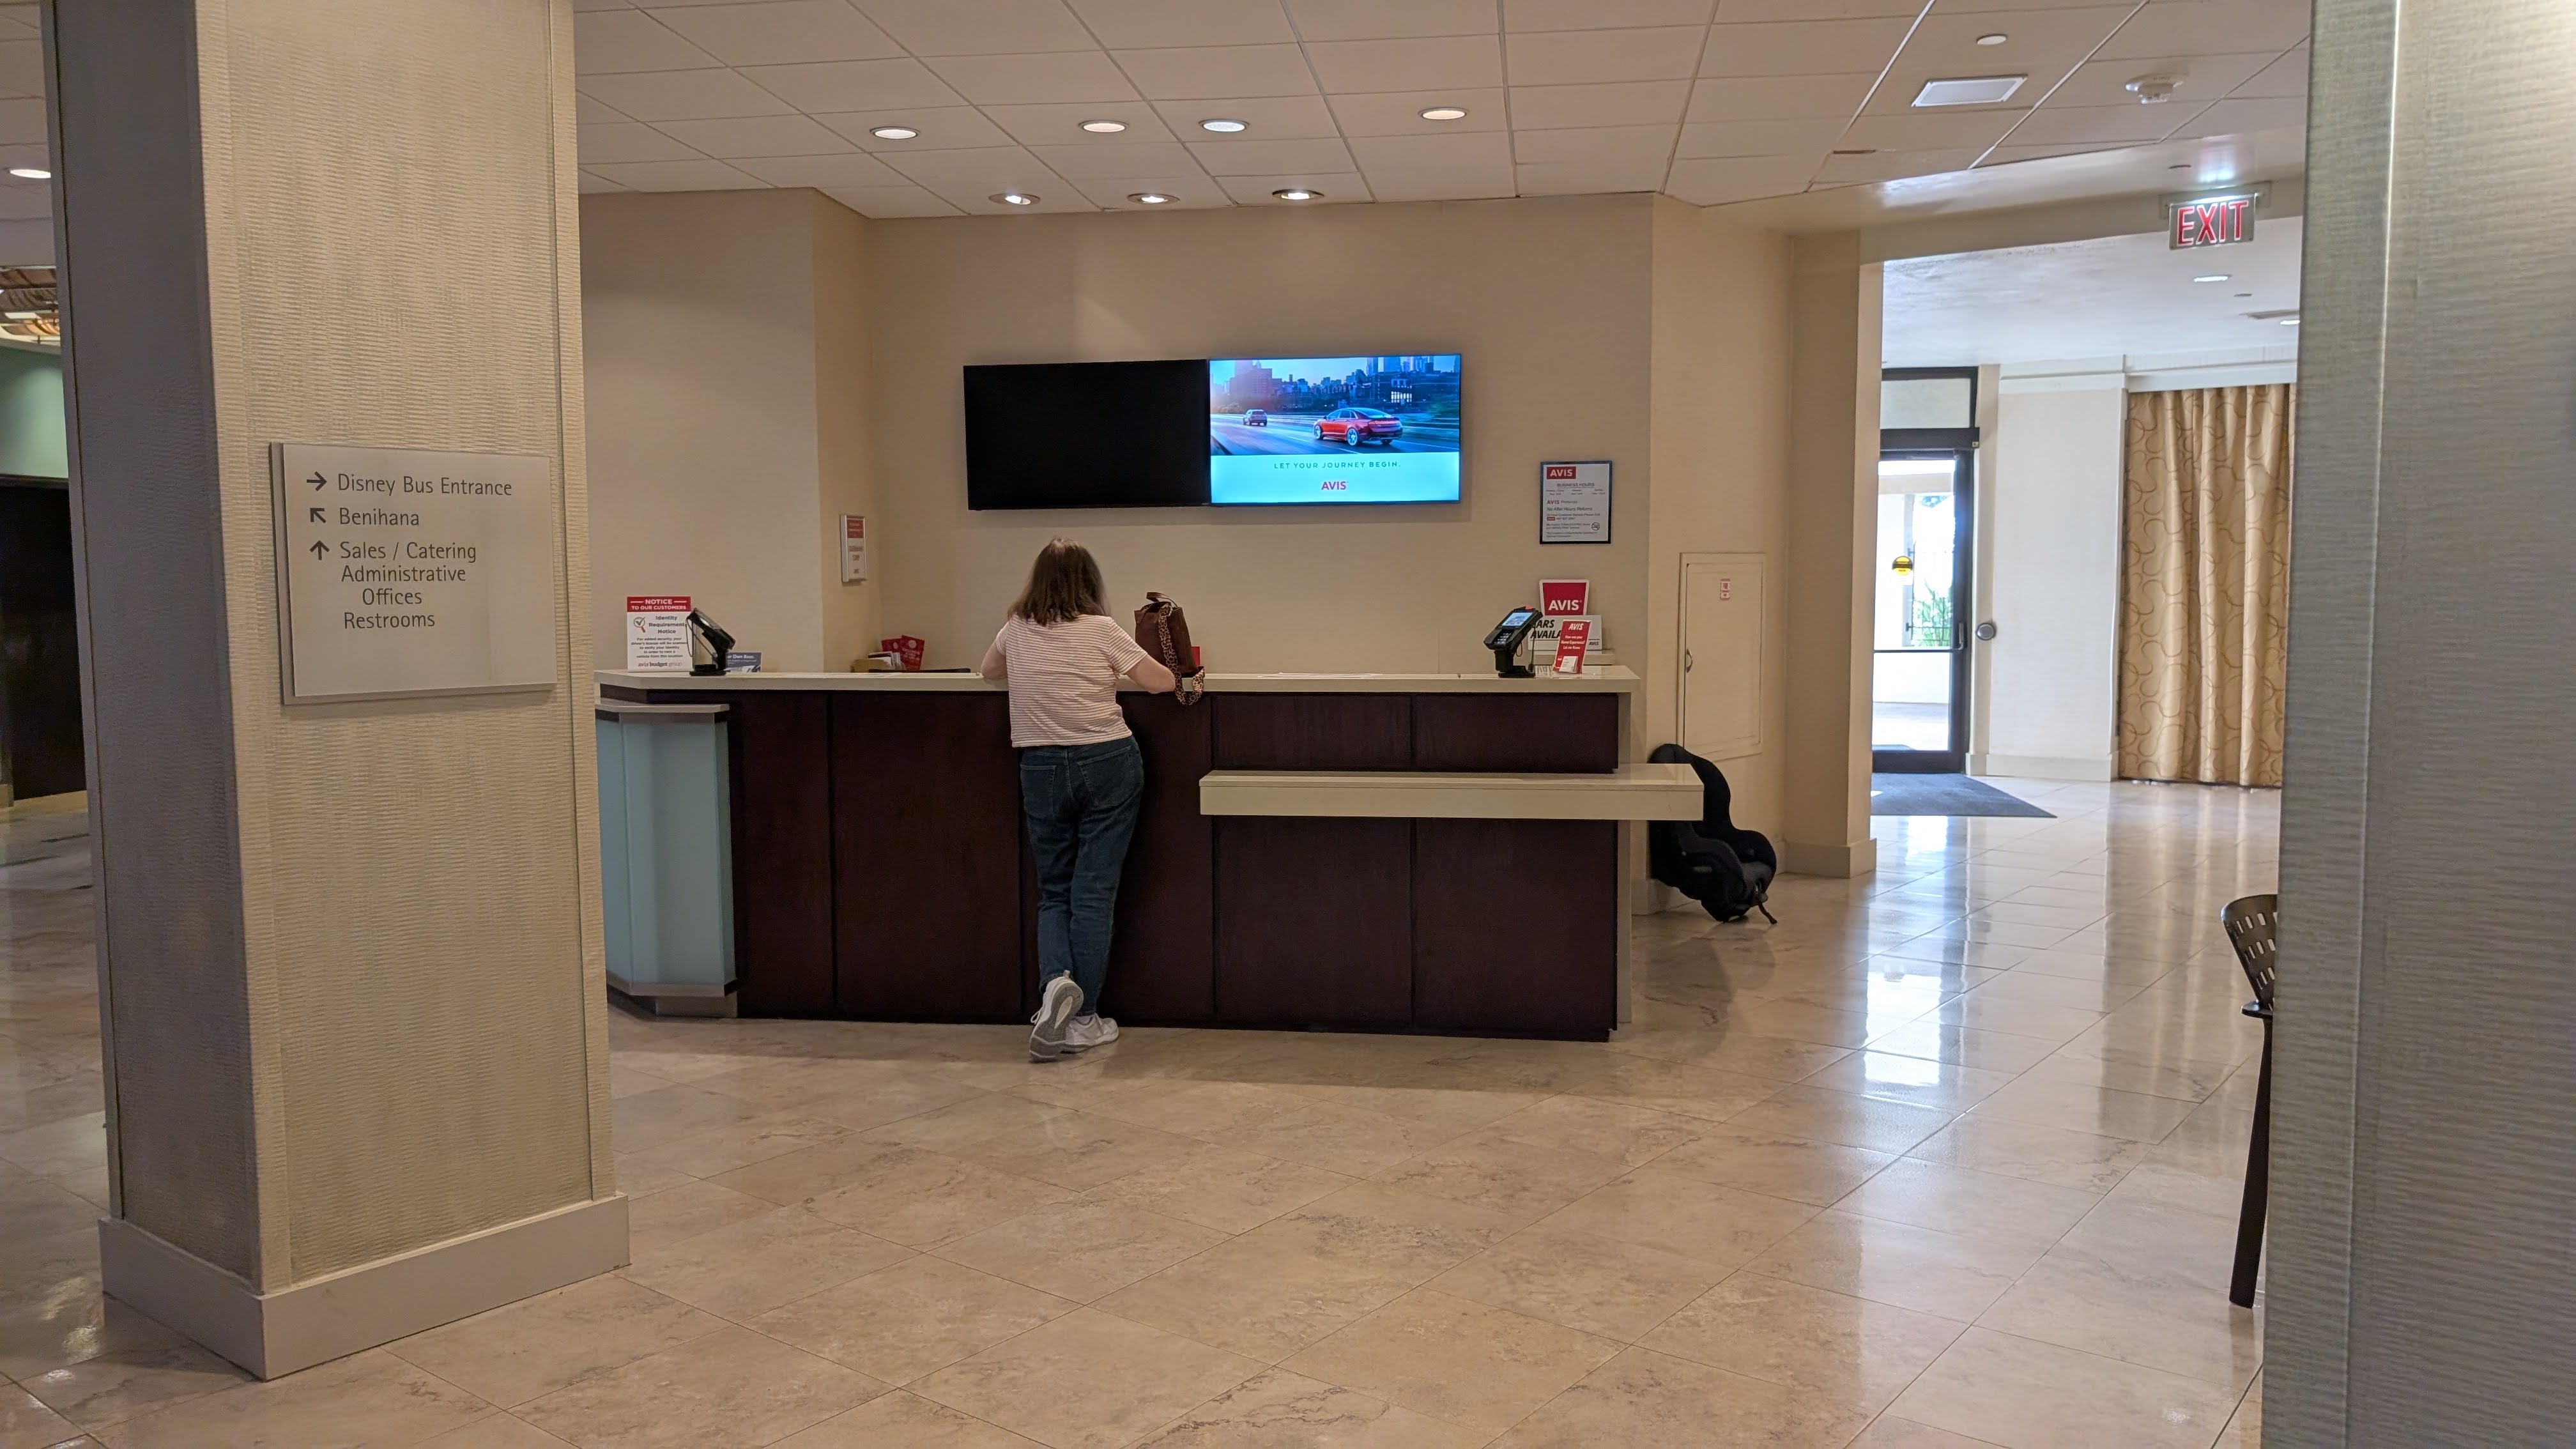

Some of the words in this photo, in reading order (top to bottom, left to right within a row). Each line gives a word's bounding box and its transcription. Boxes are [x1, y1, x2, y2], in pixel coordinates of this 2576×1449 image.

[2177, 200, 2249, 247] EXIT
[1549, 469, 1573, 477] AVIS
[337, 473, 395, 496] Disney
[403, 475, 433, 494] Bus
[441, 477, 512, 496] Entrance
[1321, 480, 1347, 491] AVIS
[339, 507, 420, 526] Benihana
[340, 542, 386, 560] Sales
[392, 542, 399, 560] /
[406, 542, 477, 563] Catering
[341, 565, 466, 582] Administrative
[362, 588, 422, 606] Offices
[1548, 599, 1580, 611] AVIS
[344, 611, 435, 629] Restrooms
[1531, 619, 1554, 628] ARS
[1530, 630, 1561, 639] AVAILA
